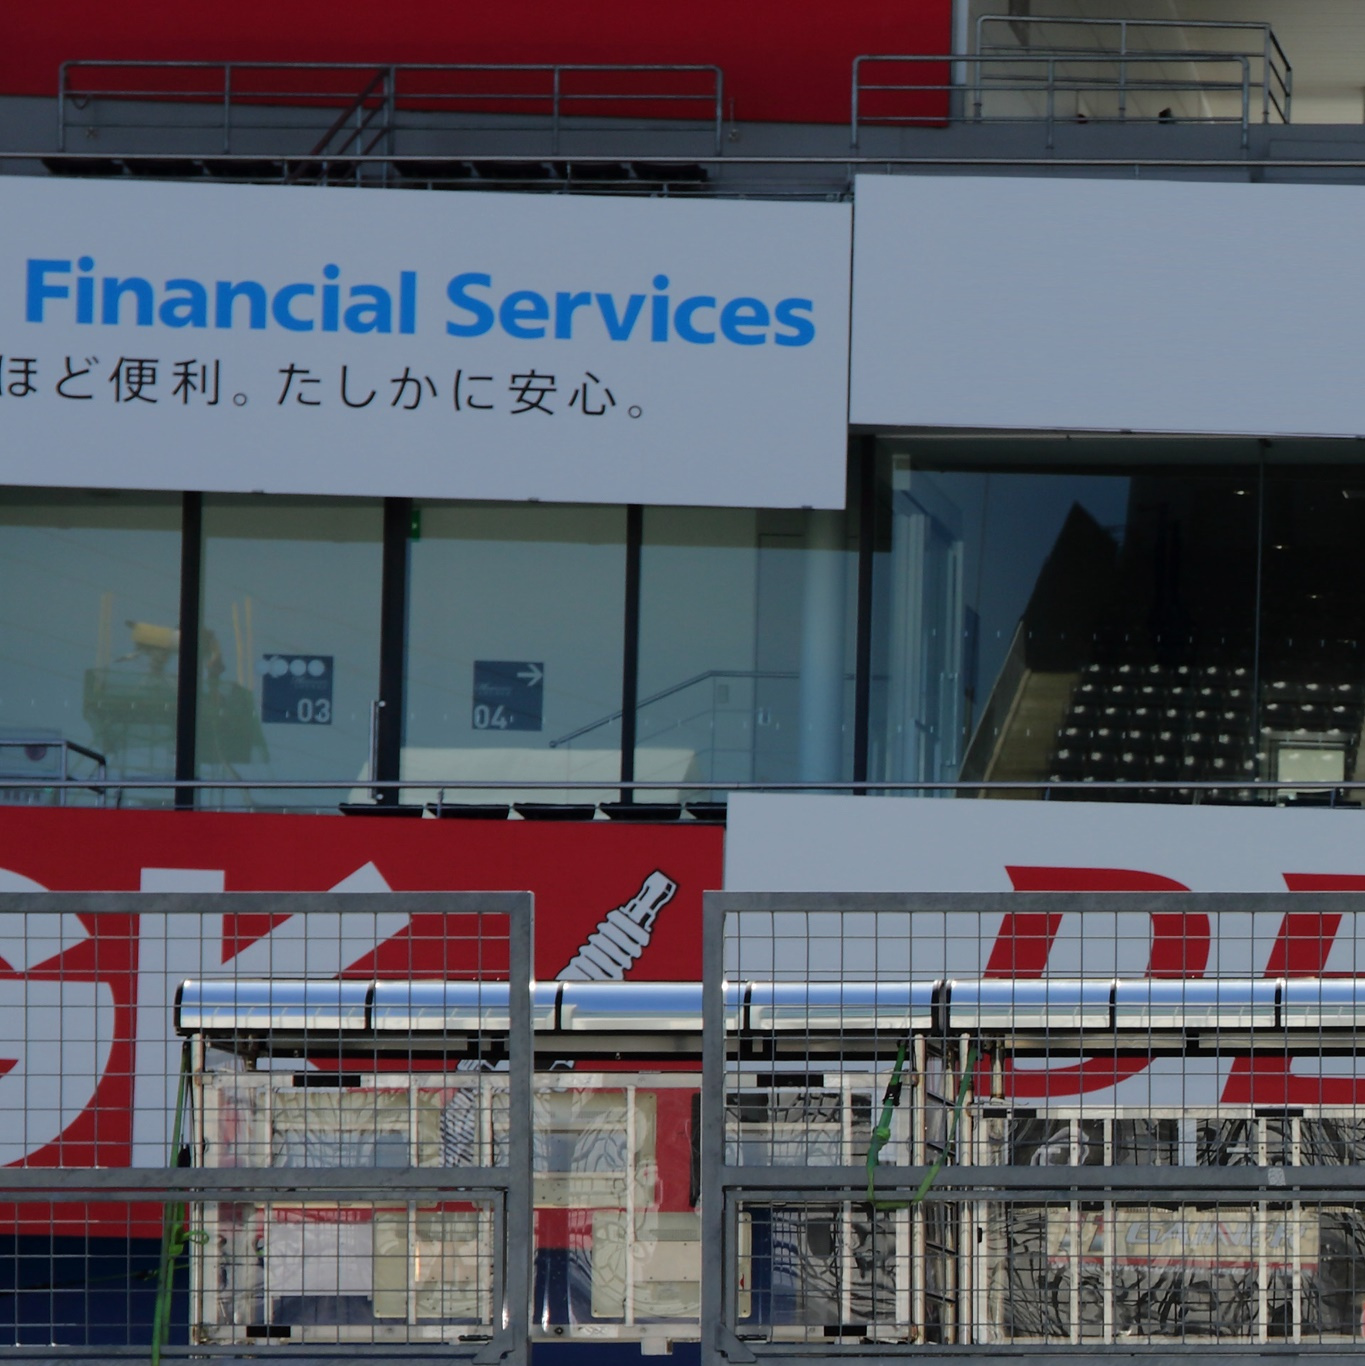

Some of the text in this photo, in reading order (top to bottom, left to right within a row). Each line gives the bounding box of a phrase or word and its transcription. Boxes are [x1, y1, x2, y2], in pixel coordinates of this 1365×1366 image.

[24, 256, 817, 347] Financial Services
[296, 698, 331, 723] 03
[473, 705, 507, 729] 04
